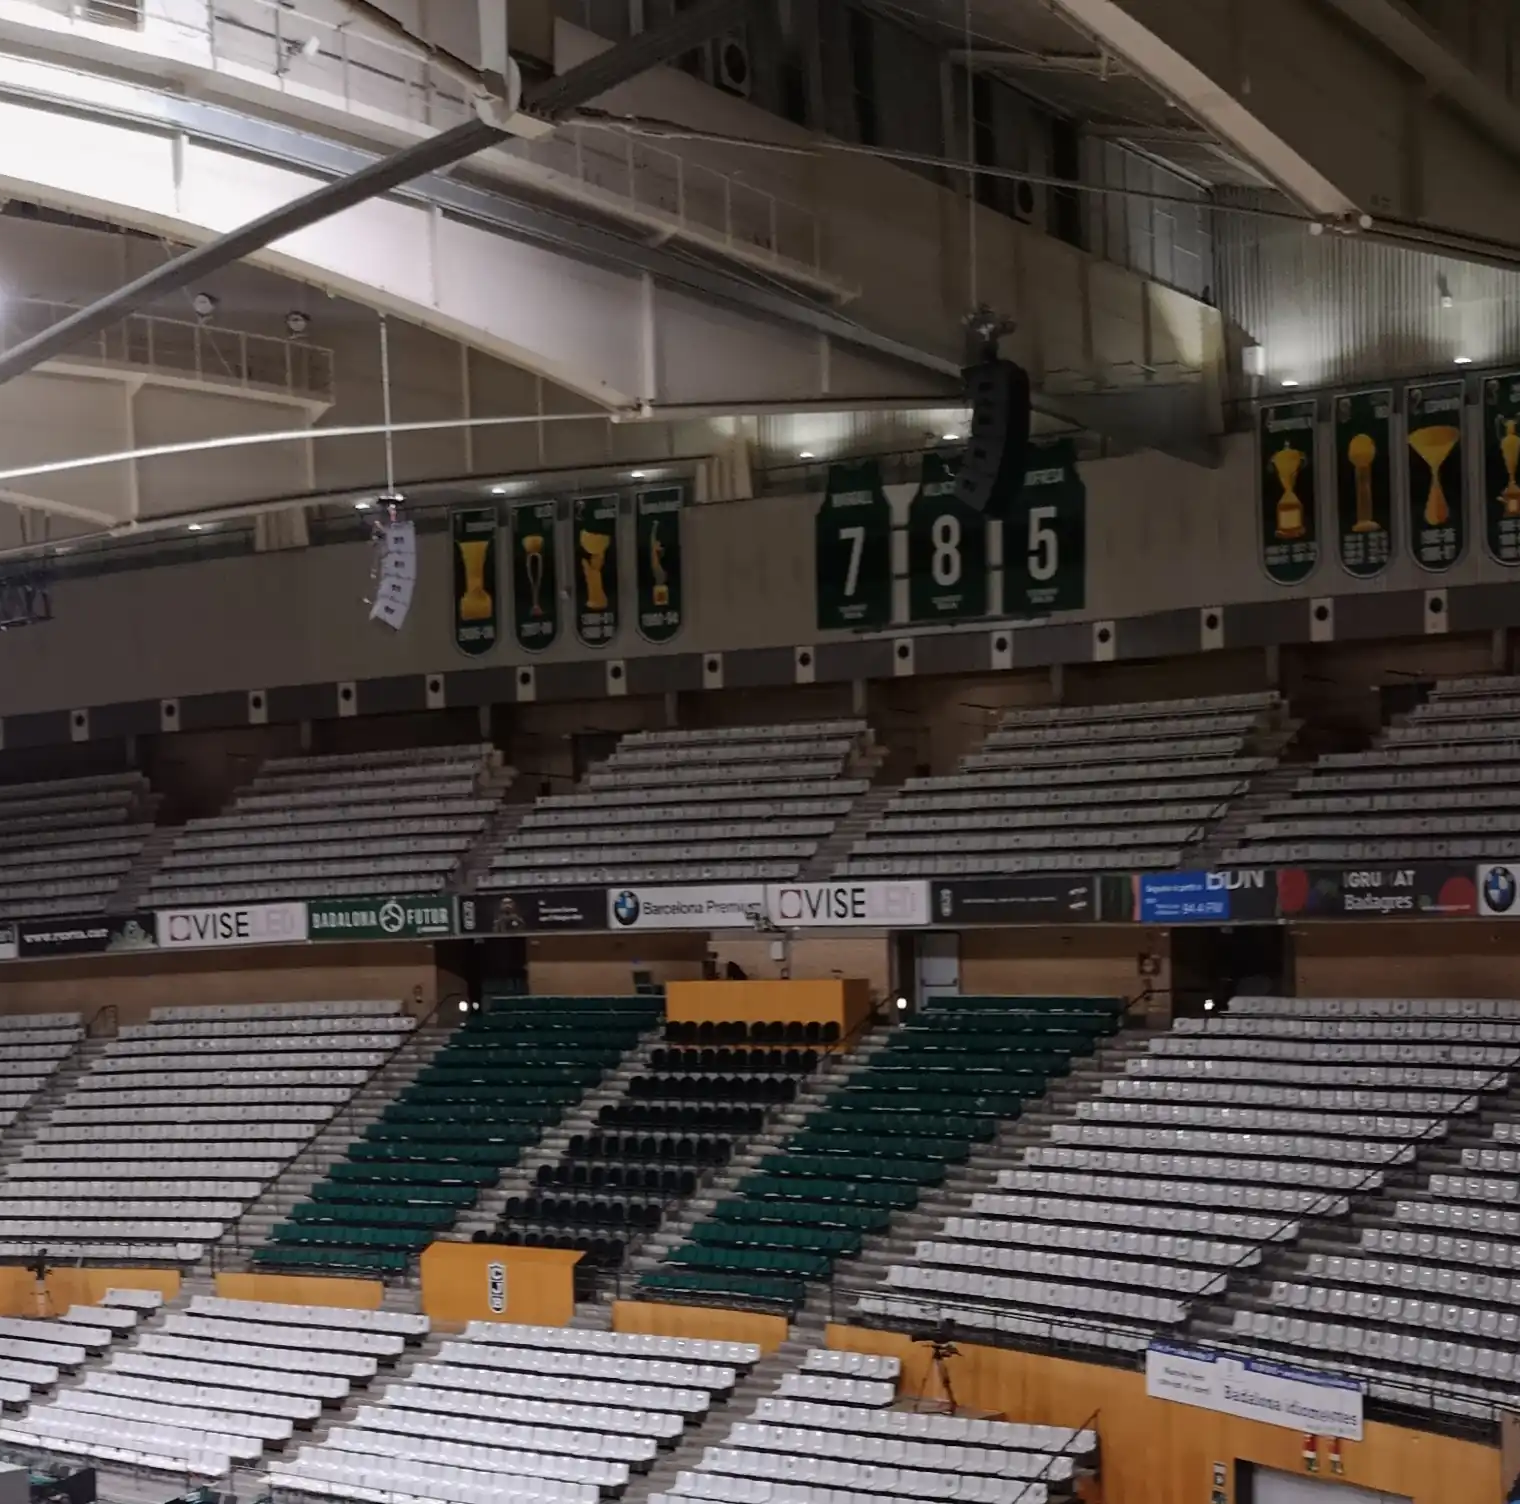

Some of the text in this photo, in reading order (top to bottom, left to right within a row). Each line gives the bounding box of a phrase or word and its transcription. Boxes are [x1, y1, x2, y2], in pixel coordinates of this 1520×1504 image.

[838, 525, 866, 597] 7
[931, 513, 962, 587] 8
[1027, 505, 1058, 581] 5
[311, 906, 449, 929] BADALONA FUTUR
[643, 899, 705, 916] Barcelona
